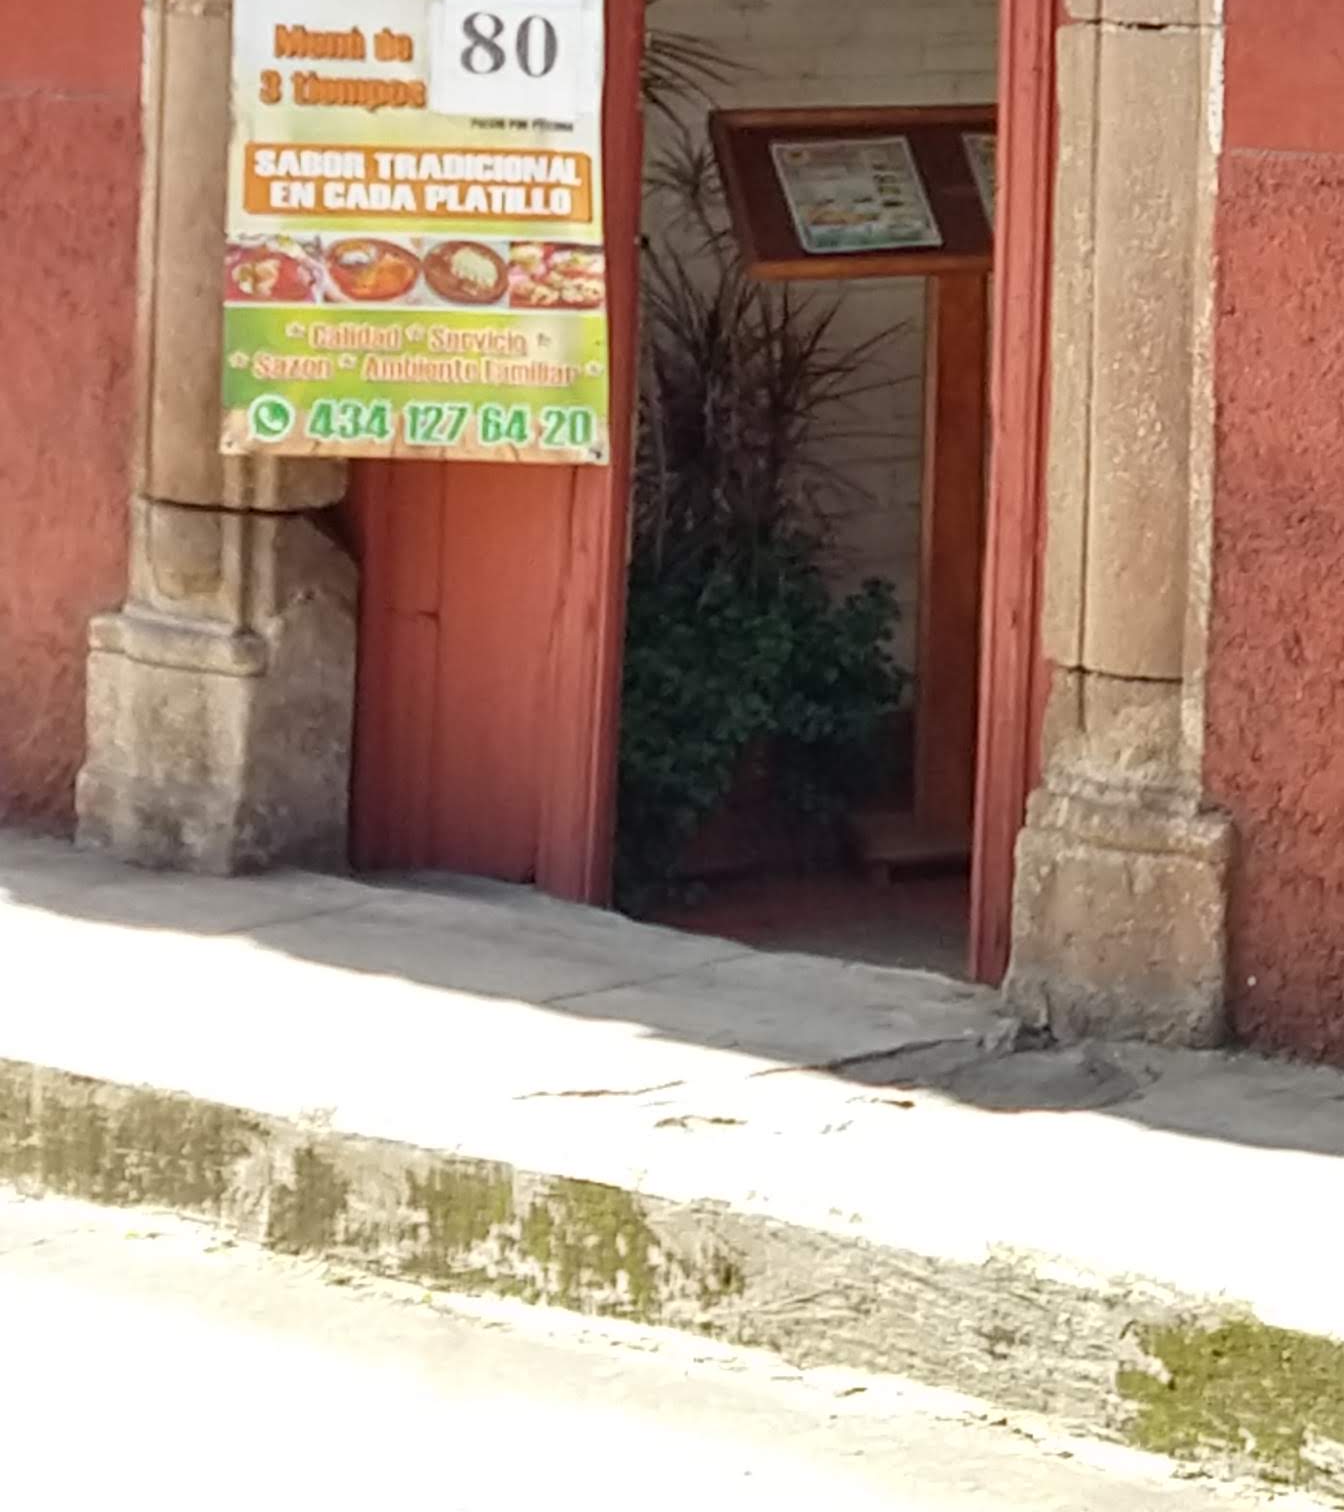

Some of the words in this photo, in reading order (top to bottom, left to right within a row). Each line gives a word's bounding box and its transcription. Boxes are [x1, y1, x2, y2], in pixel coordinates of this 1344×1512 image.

[460, 11, 559, 78] 80
[260, 70, 282, 106] 3
[254, 149, 366, 179] SABOR
[374, 151, 582, 186] TRADICIONAL
[270, 182, 317, 209] EN
[323, 184, 418, 212] CADA
[425, 185, 572, 216] PLATILLO
[309, 324, 400, 350] Calidad
[429, 327, 529, 356] Servicio
[362, 355, 477, 383] Ambiente
[307, 399, 390, 440] 434
[405, 402, 470, 443] 127
[479, 405, 530, 446] 64
[539, 407, 593, 447] 20
